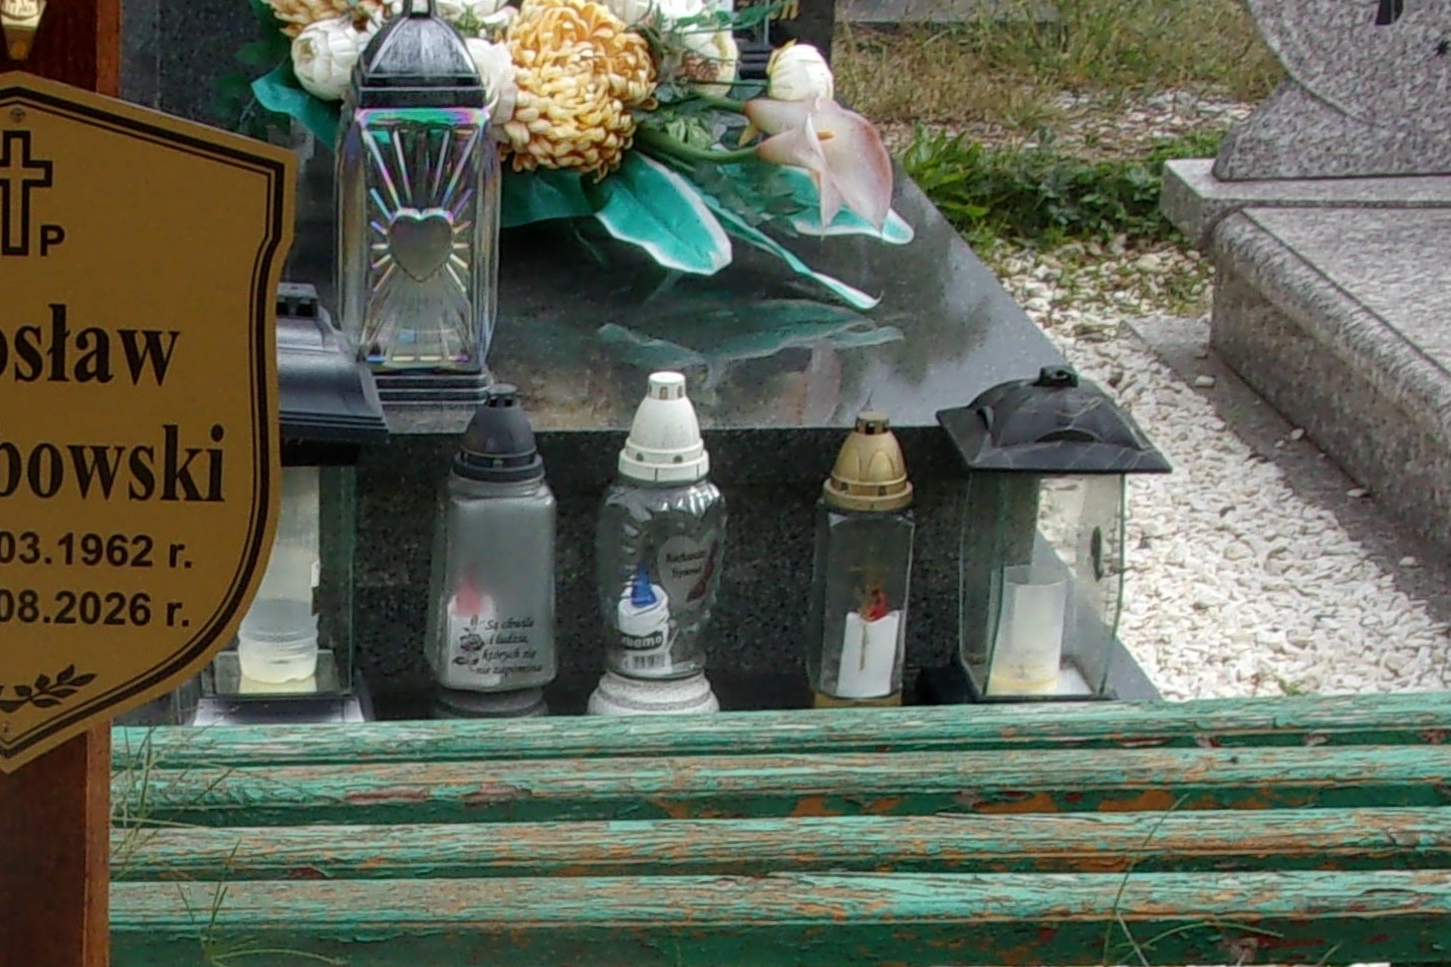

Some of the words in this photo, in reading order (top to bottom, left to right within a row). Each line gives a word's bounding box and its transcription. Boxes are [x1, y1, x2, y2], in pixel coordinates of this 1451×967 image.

[39, 223, 66, 258] P
[168, 543, 193, 570] r.
[166, 601, 190, 628] r.
